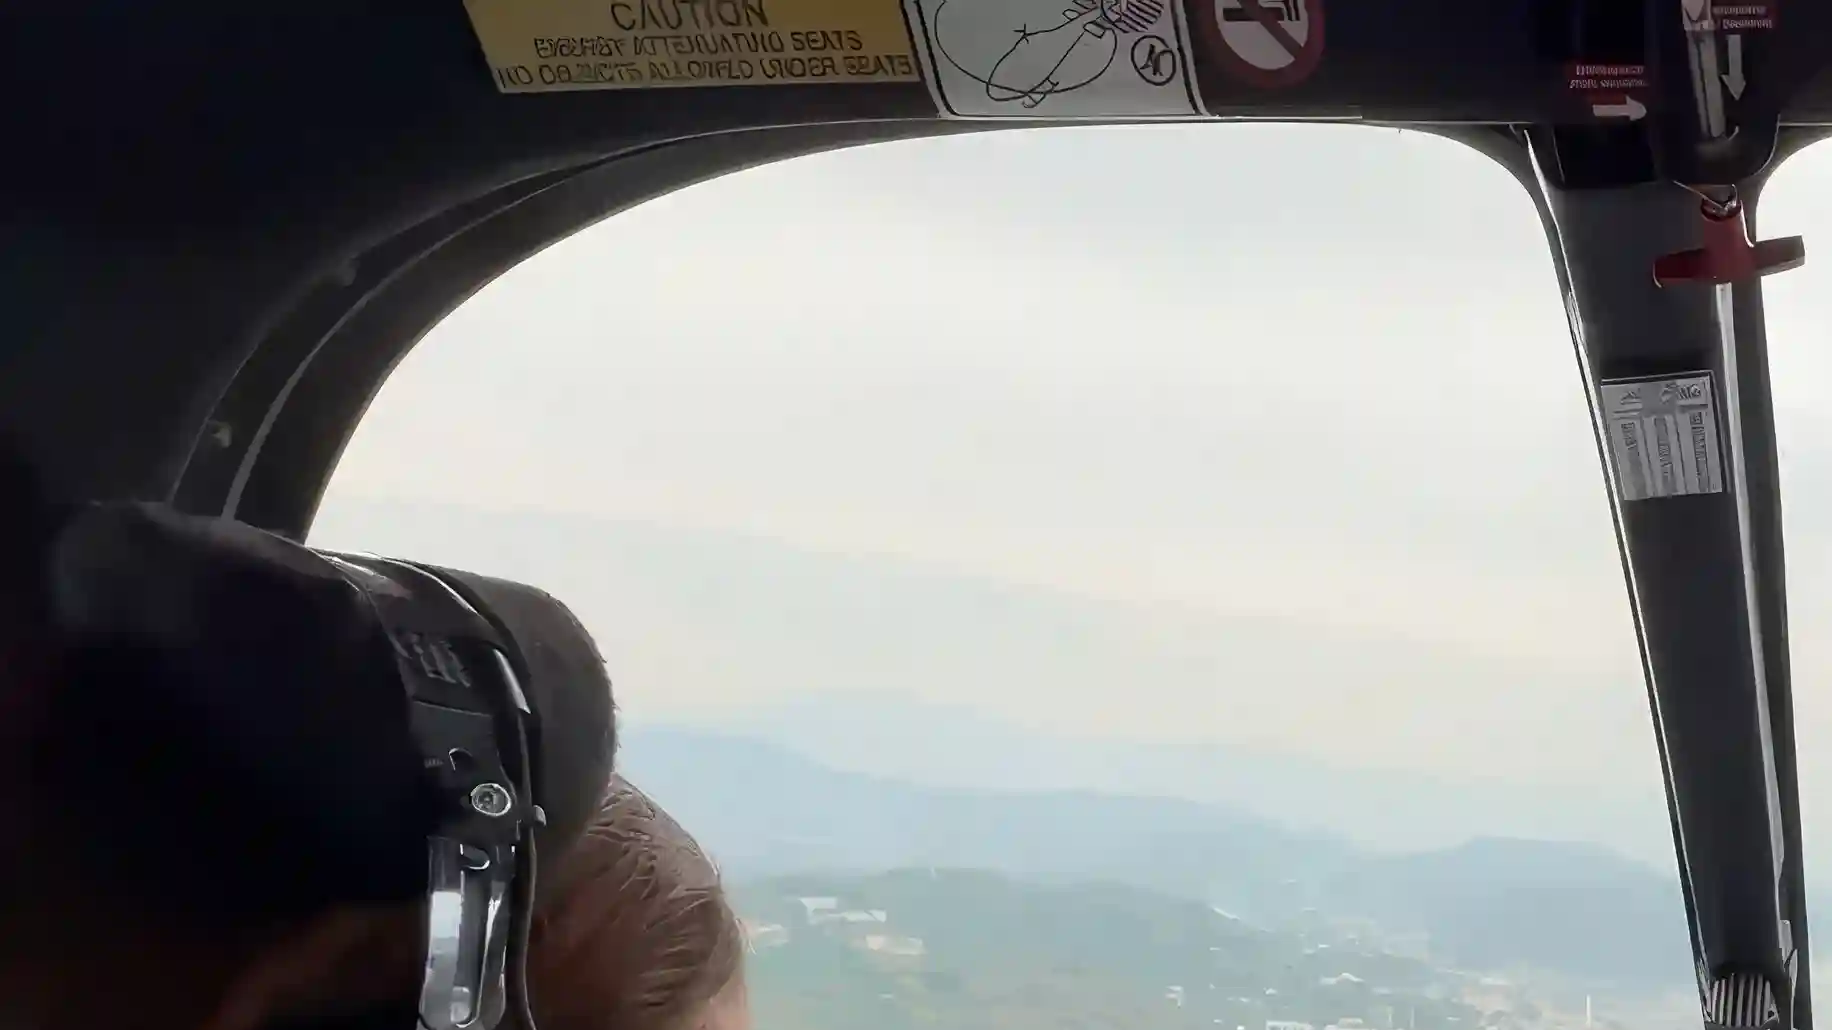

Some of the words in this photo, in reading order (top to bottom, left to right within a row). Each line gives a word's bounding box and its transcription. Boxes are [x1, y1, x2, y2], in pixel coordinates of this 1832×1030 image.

[611, 0, 769, 31] CAUTION
[790, 30, 864, 51] SEATS
[538, 61, 642, 86] OBCTS
